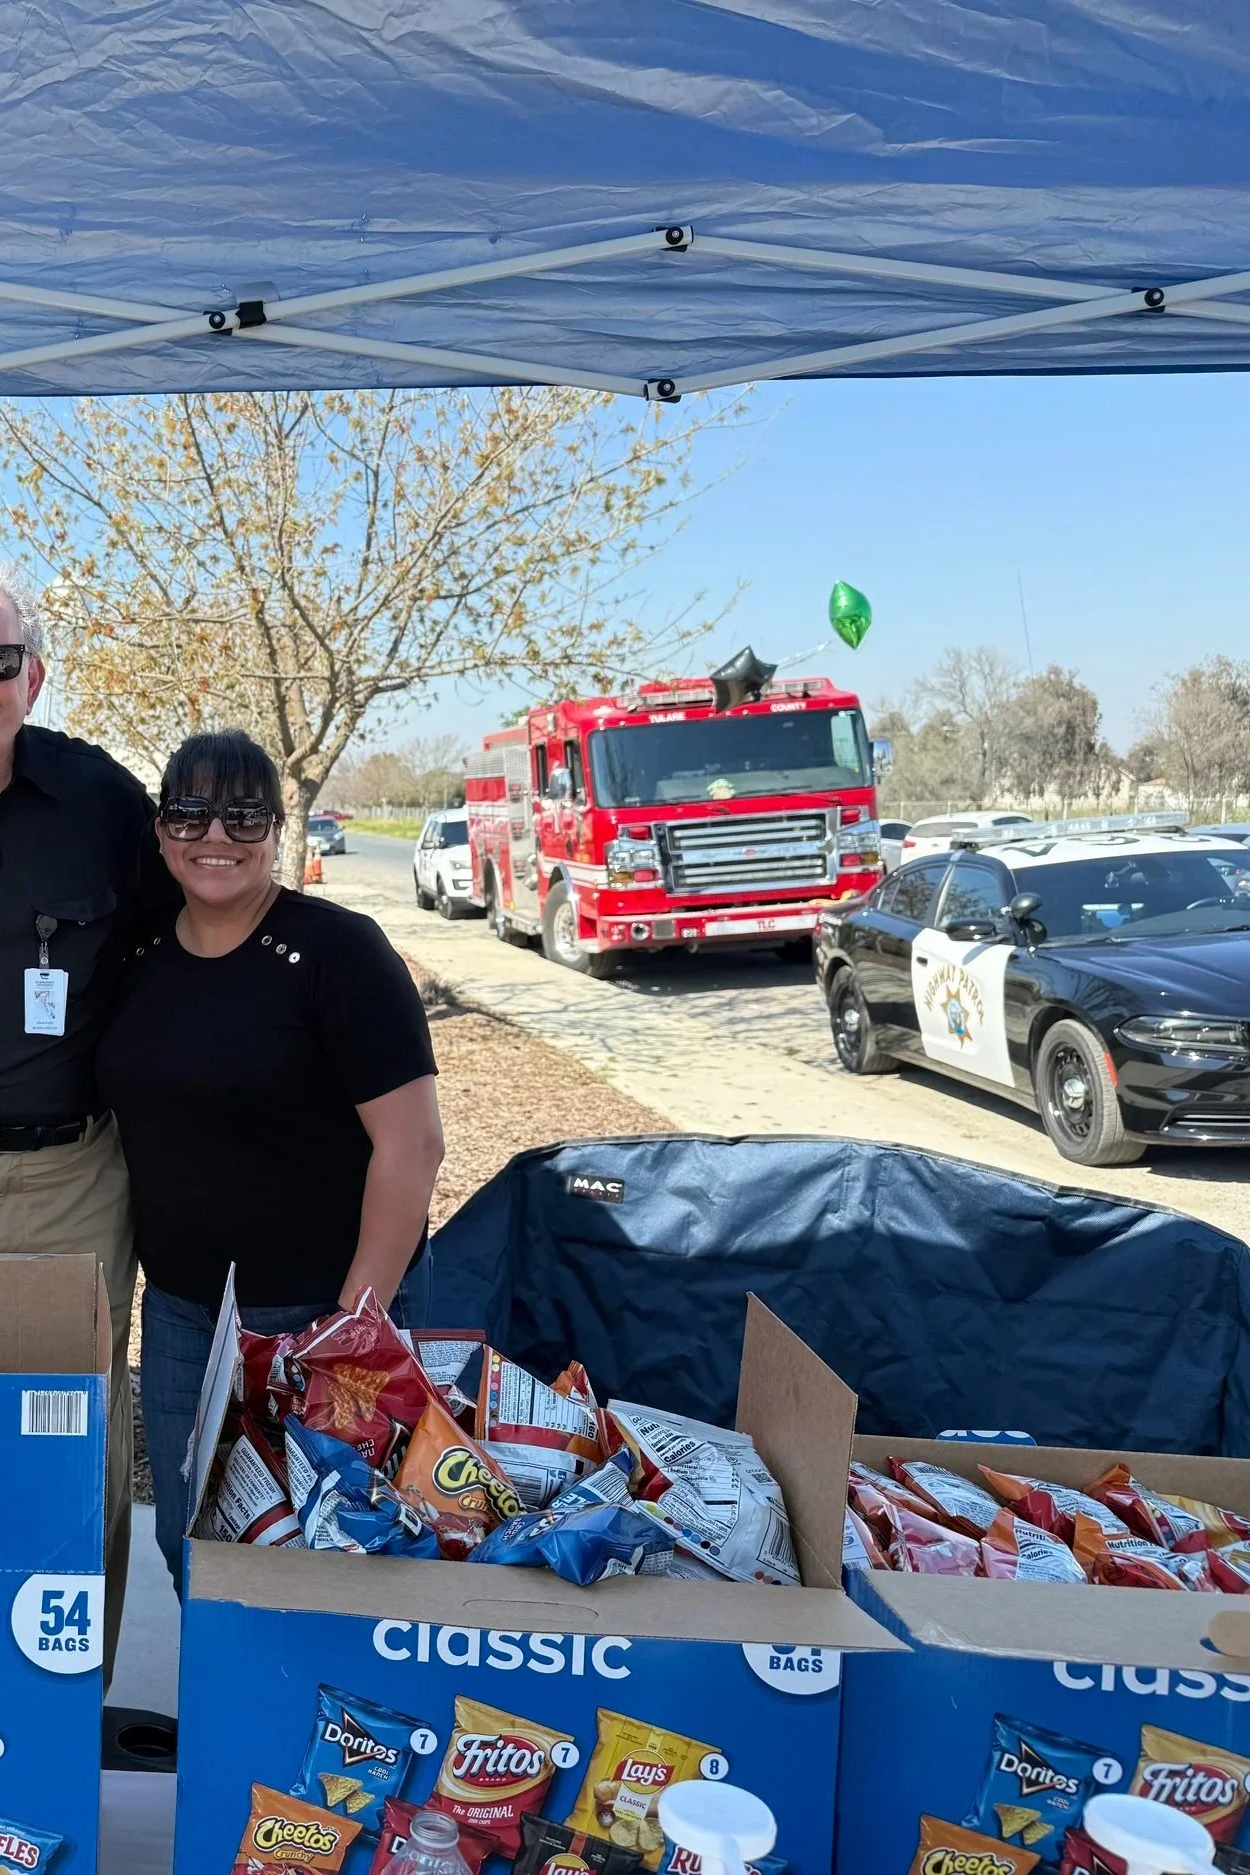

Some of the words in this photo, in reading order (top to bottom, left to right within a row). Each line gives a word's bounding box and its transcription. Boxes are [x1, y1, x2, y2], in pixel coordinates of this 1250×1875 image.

[650, 712, 686, 723] TULARE
[770, 702, 807, 712] COUNTY
[757, 920, 775, 929] TLC
[924, 965, 956, 1012] HIGHWAY
[959, 969, 985, 1025] PATROL
[573, 1178, 623, 1193] MAC
[664, 1441, 696, 1464] Calories
[240, 1447, 264, 1478] GUARANTEED
[262, 1474, 276, 1494] FRESH
[437, 1449, 528, 1517] Cheeto
[235, 1497, 252, 1520] Facts
[219, 1524, 234, 1542] 150
[1015, 1529, 1047, 1540] Nutriti
[1107, 1540, 1147, 1550] Nutrition
[1021, 1550, 1051, 1560] Calorie
[40, 1590, 91, 1636] 54
[38, 1637, 90, 1652] BAGS
[373, 1619, 633, 1680] classic
[769, 1655, 823, 1673] BAGS
[324, 1722, 398, 1763] Doritos
[419, 1734, 429, 1749] 7
[453, 1733, 545, 1777] Fritos
[561, 1747, 571, 1763] 7
[621, 1758, 667, 1786] Lay's
[709, 1759, 719, 1775] 8
[999, 1753, 1079, 1794] Doritos
[1103, 1763, 1112, 1779] 7
[1142, 1763, 1240, 1805] Fritos
[452, 1805, 465, 1815] The
[467, 1805, 514, 1818] ORIGINAL
[619, 1795, 647, 1810] CLASSIC
[254, 1817, 338, 1851] Cheetos
[273, 1849, 314, 1862] Crunchy
[923, 1848, 1014, 1875] Cheetos
